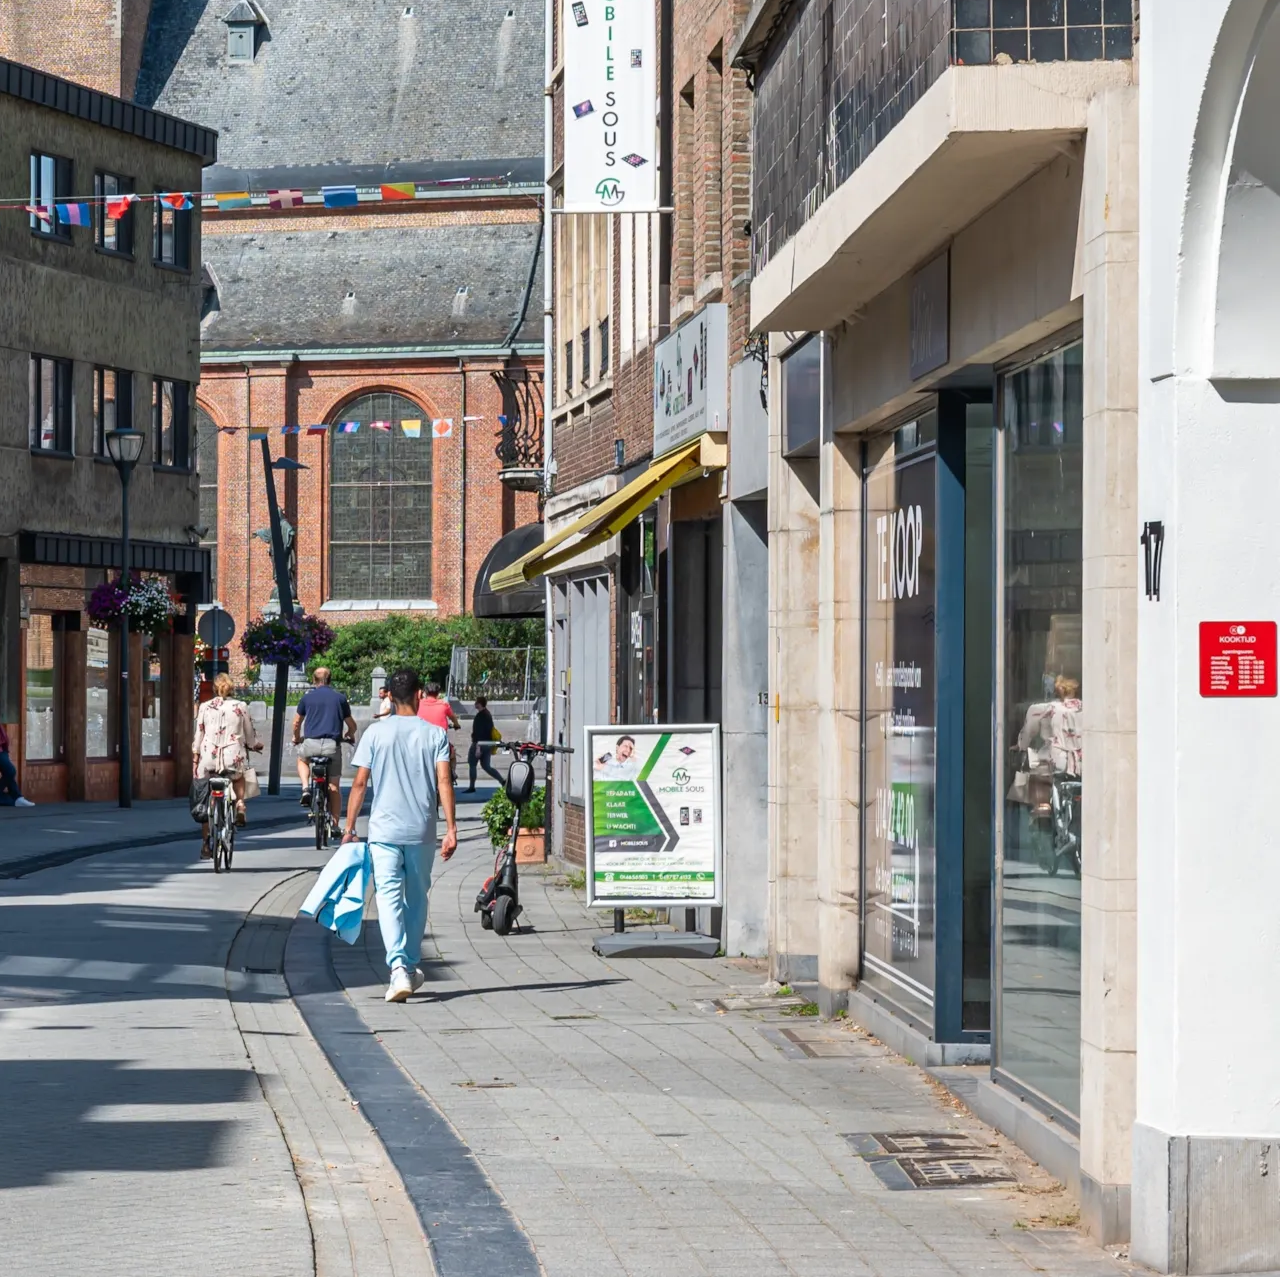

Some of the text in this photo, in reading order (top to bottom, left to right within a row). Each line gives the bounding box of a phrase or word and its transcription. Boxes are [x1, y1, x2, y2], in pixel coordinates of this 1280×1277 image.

[602, 91, 619, 167] SOUS
[876, 505, 923, 601] TE KOOP
[1140, 521, 1165, 602] 17
[685, 785, 705, 793] SOUS
